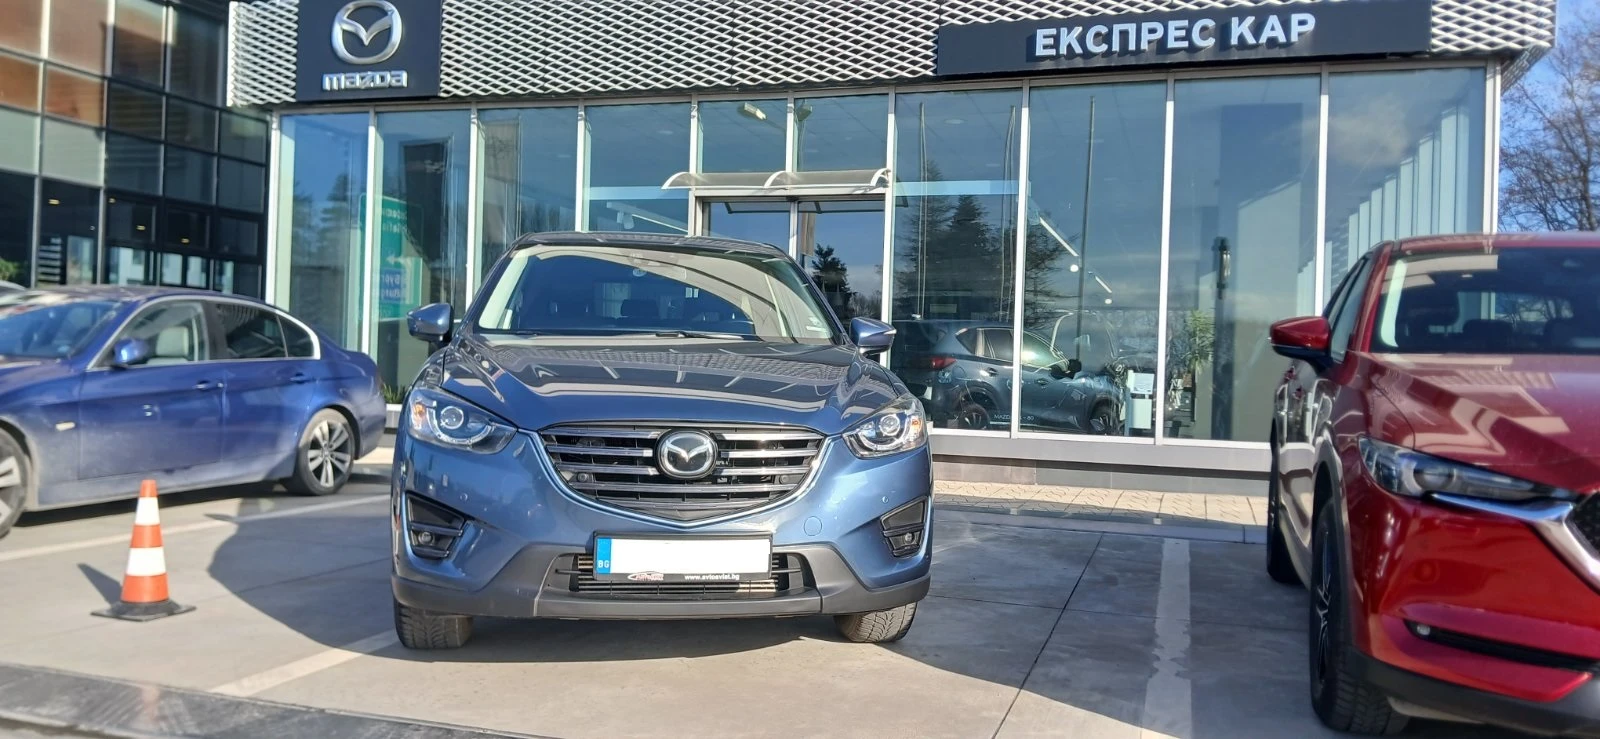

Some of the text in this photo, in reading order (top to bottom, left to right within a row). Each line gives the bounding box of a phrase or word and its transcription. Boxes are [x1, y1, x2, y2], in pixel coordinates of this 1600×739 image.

[1034, 12, 1316, 56] ЕКСПРЕС КАР
[322, 70, 408, 91] mazda
[597, 559, 610, 568] BG
